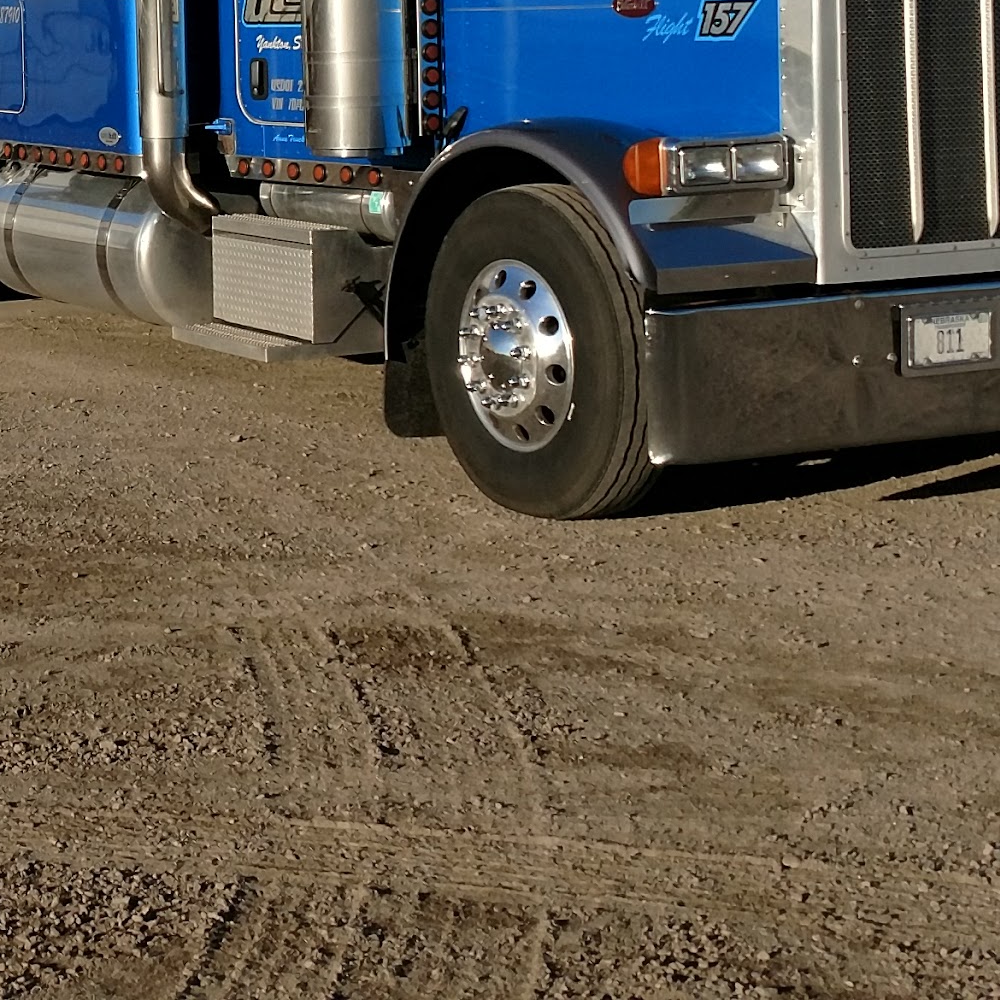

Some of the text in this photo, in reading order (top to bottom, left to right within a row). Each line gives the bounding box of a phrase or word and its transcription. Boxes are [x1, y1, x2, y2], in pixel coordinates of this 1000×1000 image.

[642, 1, 756, 44] Flight 157
[256, 34, 302, 53] Yankton, S
[936, 328, 964, 355] 811
